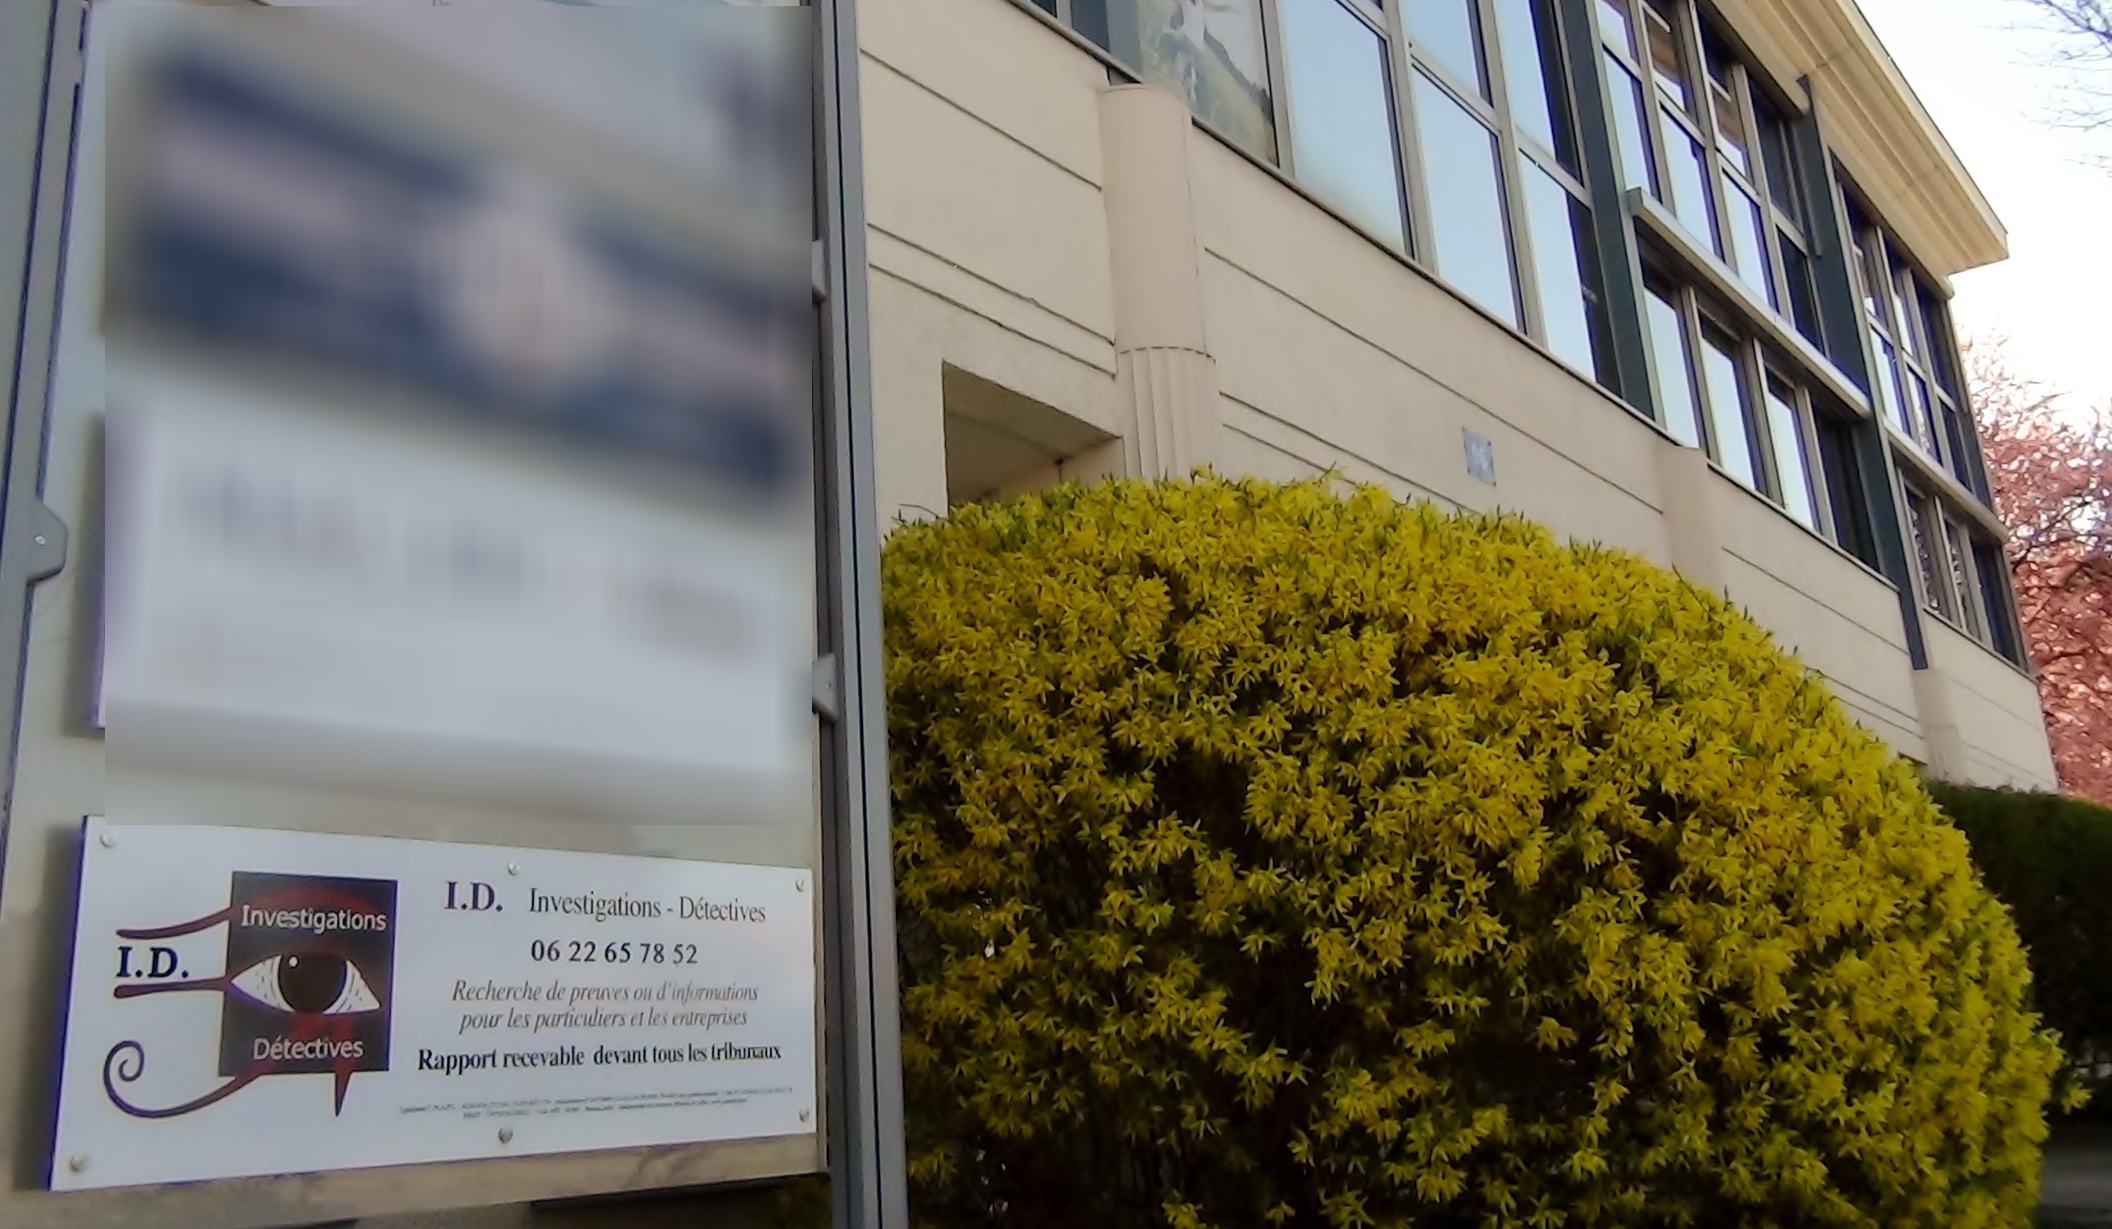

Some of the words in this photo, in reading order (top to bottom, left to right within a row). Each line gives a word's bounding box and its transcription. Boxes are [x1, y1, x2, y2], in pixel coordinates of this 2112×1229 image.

[443, 881, 504, 912] I.D.
[529, 887, 662, 922] Investigations
[679, 895, 767, 923] Détectives
[240, 904, 388, 934] Investigations
[115, 946, 190, 979] I.D.
[531, 939, 561, 962] 06
[568, 940, 597, 963] 22
[604, 941, 632, 963] 65
[640, 943, 665, 964] 78
[673, 944, 699, 965] 52
[451, 980, 540, 1002] Recherche
[546, 980, 564, 1002] de
[568, 984, 630, 1007] preuves
[633, 984, 652, 1001] ou
[656, 981, 759, 1006] d'informations
[457, 1013, 504, 1036] pour
[507, 1008, 530, 1029] les
[533, 1007, 627, 1036] particuliers
[630, 1010, 646, 1027] et
[648, 1008, 669, 1027] les
[671, 1008, 749, 1031] entreprises
[252, 1036, 365, 1063] Détectives
[417, 1048, 498, 1076] Rapport
[502, 1046, 585, 1069] recevable
[592, 1045, 649, 1066] devant
[652, 1044, 685, 1063] tous
[687, 1043, 708, 1062] les
[711, 1041, 783, 1062] tribunaux
